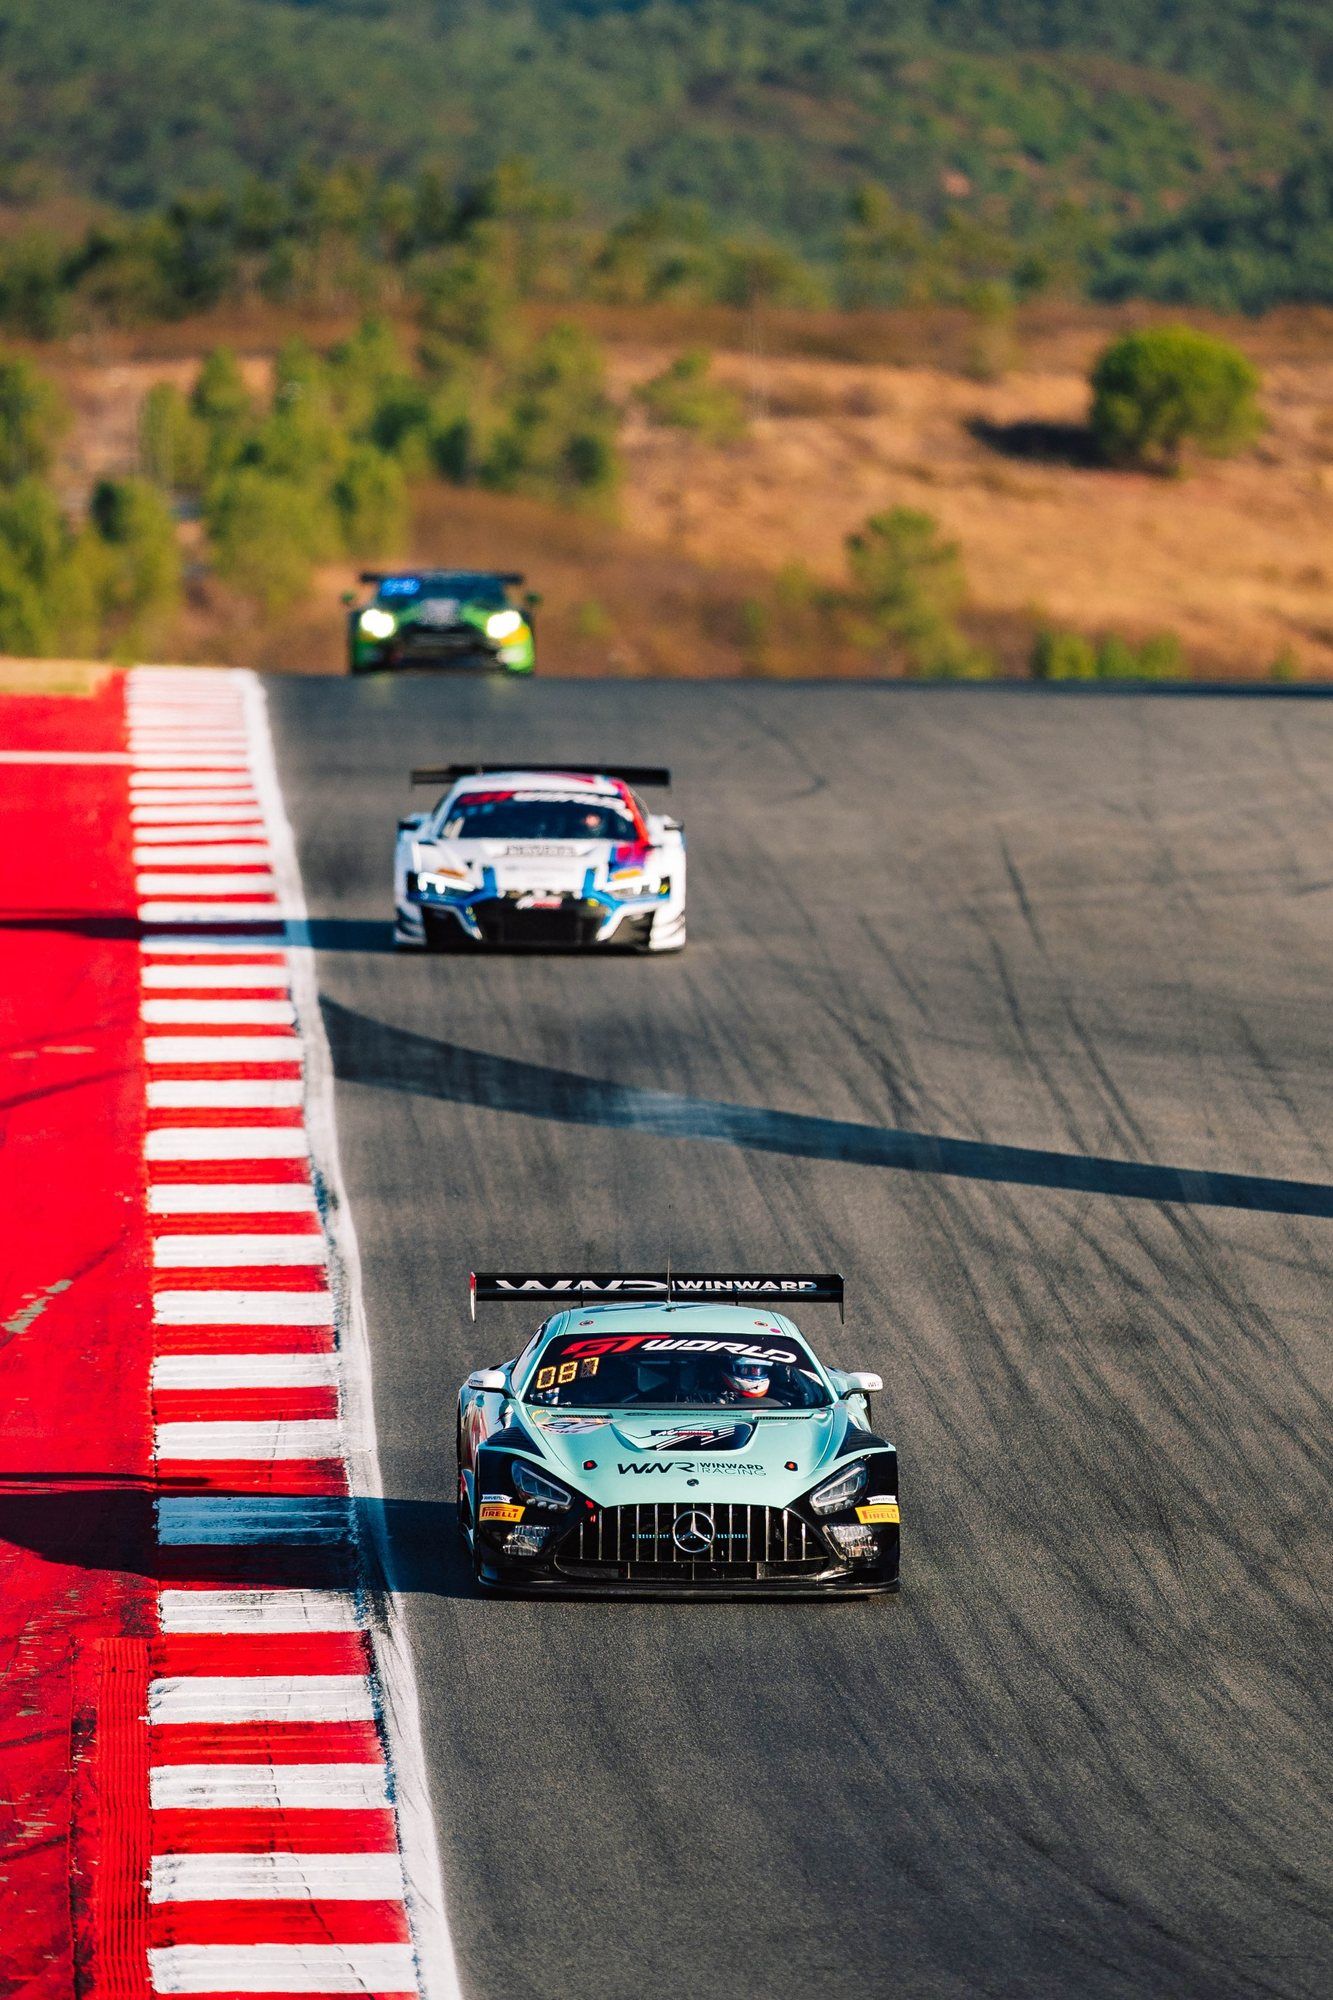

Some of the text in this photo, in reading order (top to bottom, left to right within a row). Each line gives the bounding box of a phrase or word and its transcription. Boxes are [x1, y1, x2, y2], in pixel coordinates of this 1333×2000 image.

[677, 1280, 818, 1291] WINWARD
[617, 1461, 764, 1475] WNR WINWARD
[701, 1467, 767, 1477] RACING
[482, 1506, 519, 1518] PIRELLI
